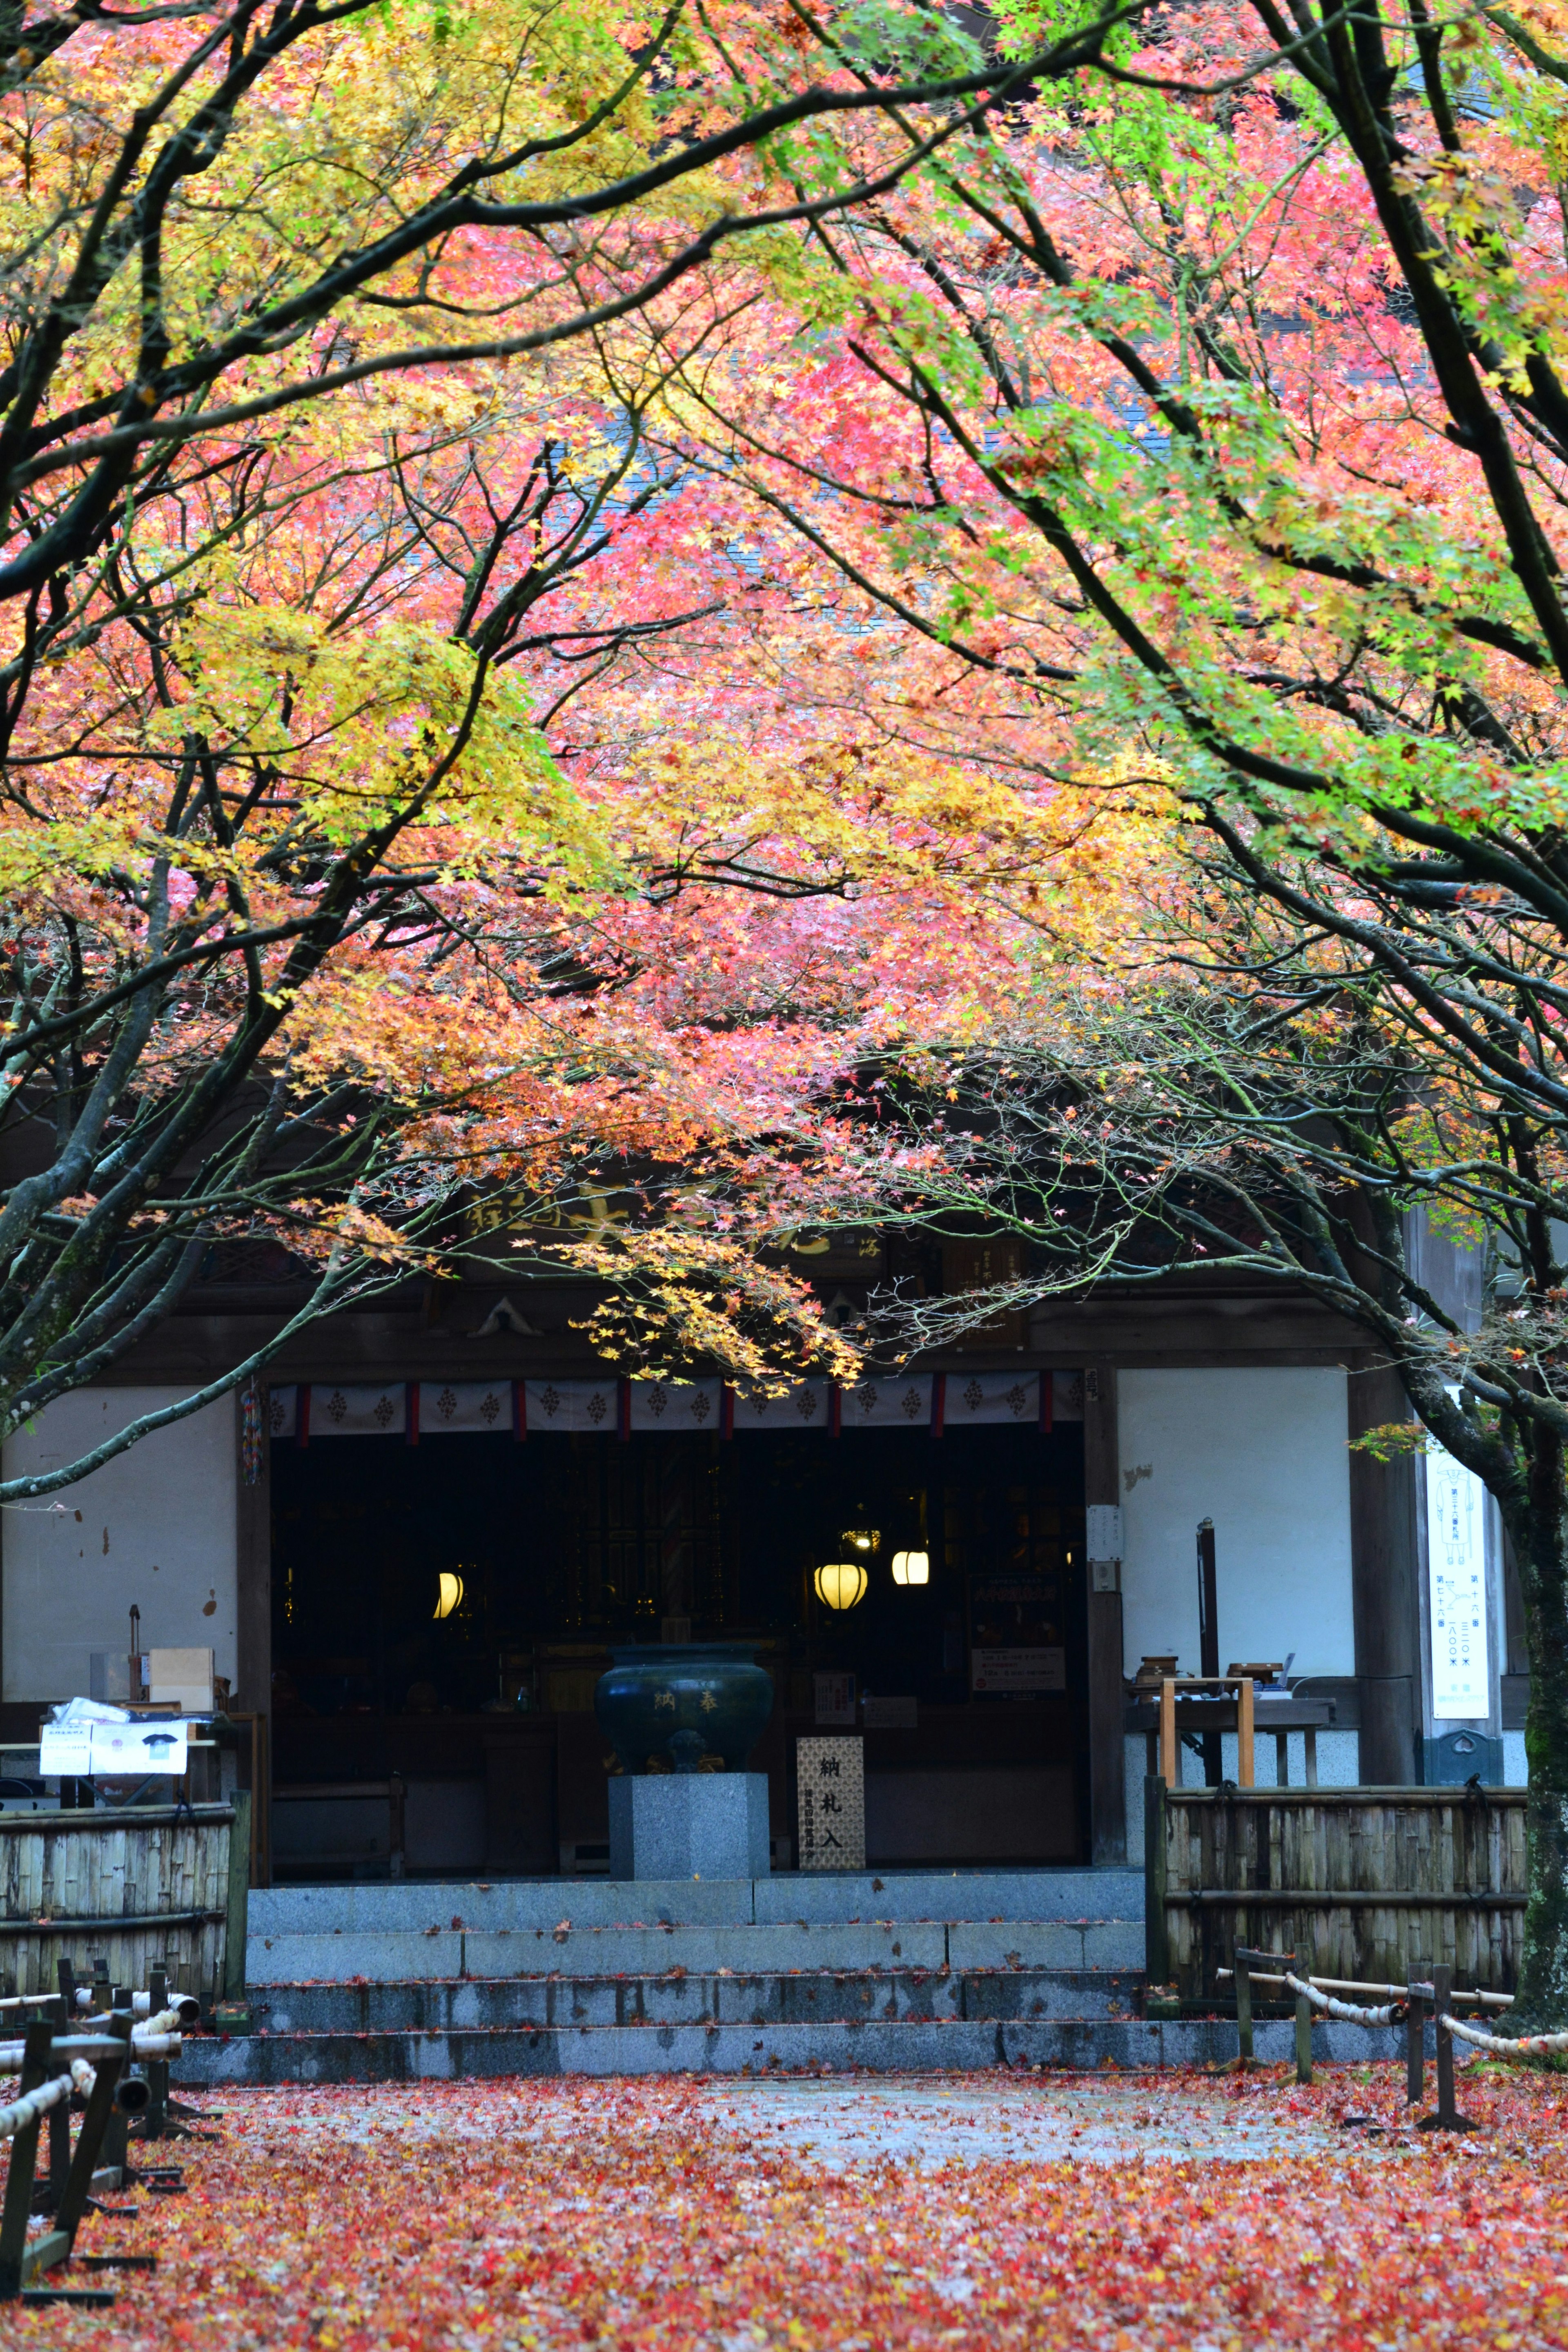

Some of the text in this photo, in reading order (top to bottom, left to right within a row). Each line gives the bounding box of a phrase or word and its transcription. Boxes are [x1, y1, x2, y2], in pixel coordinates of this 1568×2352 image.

[1437, 1575, 1445, 1627] 第七十六番
[1471, 1575, 1479, 1627] 第十六番
[819, 1757, 843, 1848] 納札入
